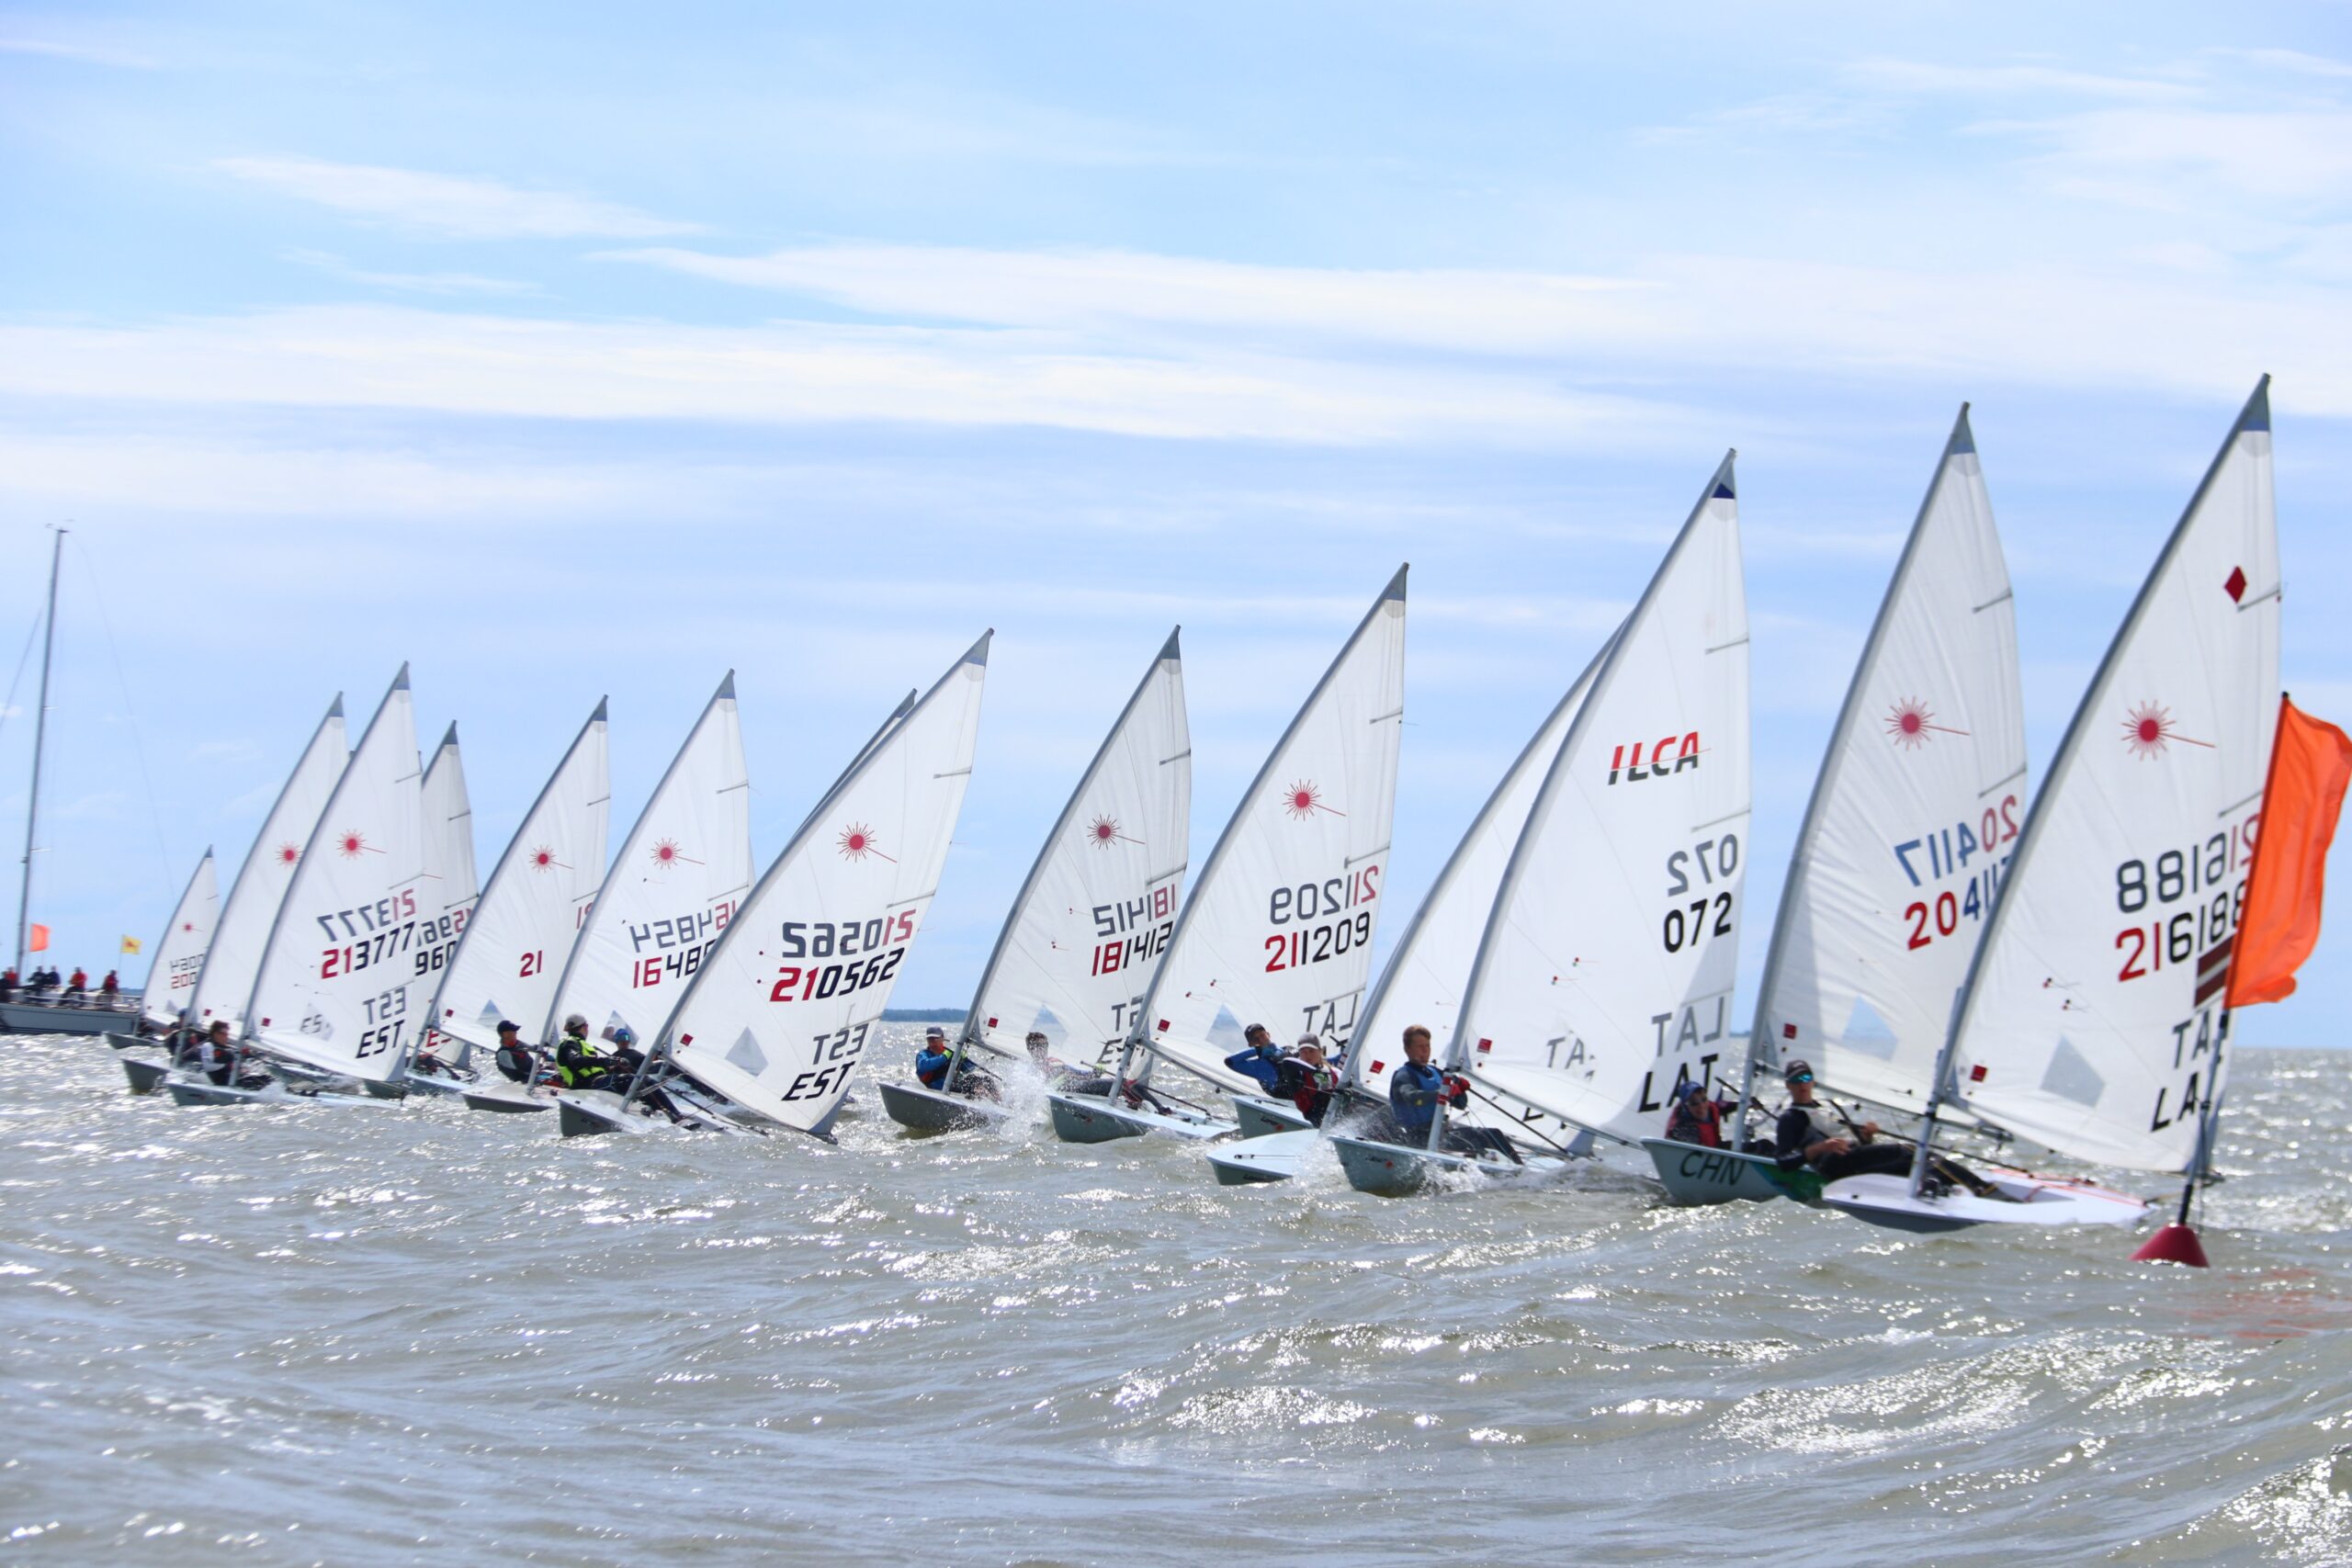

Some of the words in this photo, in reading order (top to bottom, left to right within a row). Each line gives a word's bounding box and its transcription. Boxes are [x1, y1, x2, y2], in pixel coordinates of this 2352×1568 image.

[1608, 731, 1699, 785] ILCA
[1663, 891, 1732, 953] 072
[1904, 854, 2010, 951] 20411
[321, 920, 415, 979] 213777
[519, 950, 543, 978] 21
[1091, 920, 1174, 976] 181412
[1264, 911, 1371, 973] 211209
[769, 947, 905, 1002] 210562
[355, 1019, 405, 1059] EST
[781, 1061, 855, 1102] EST
[1679, 1151, 1746, 1186] CHN
